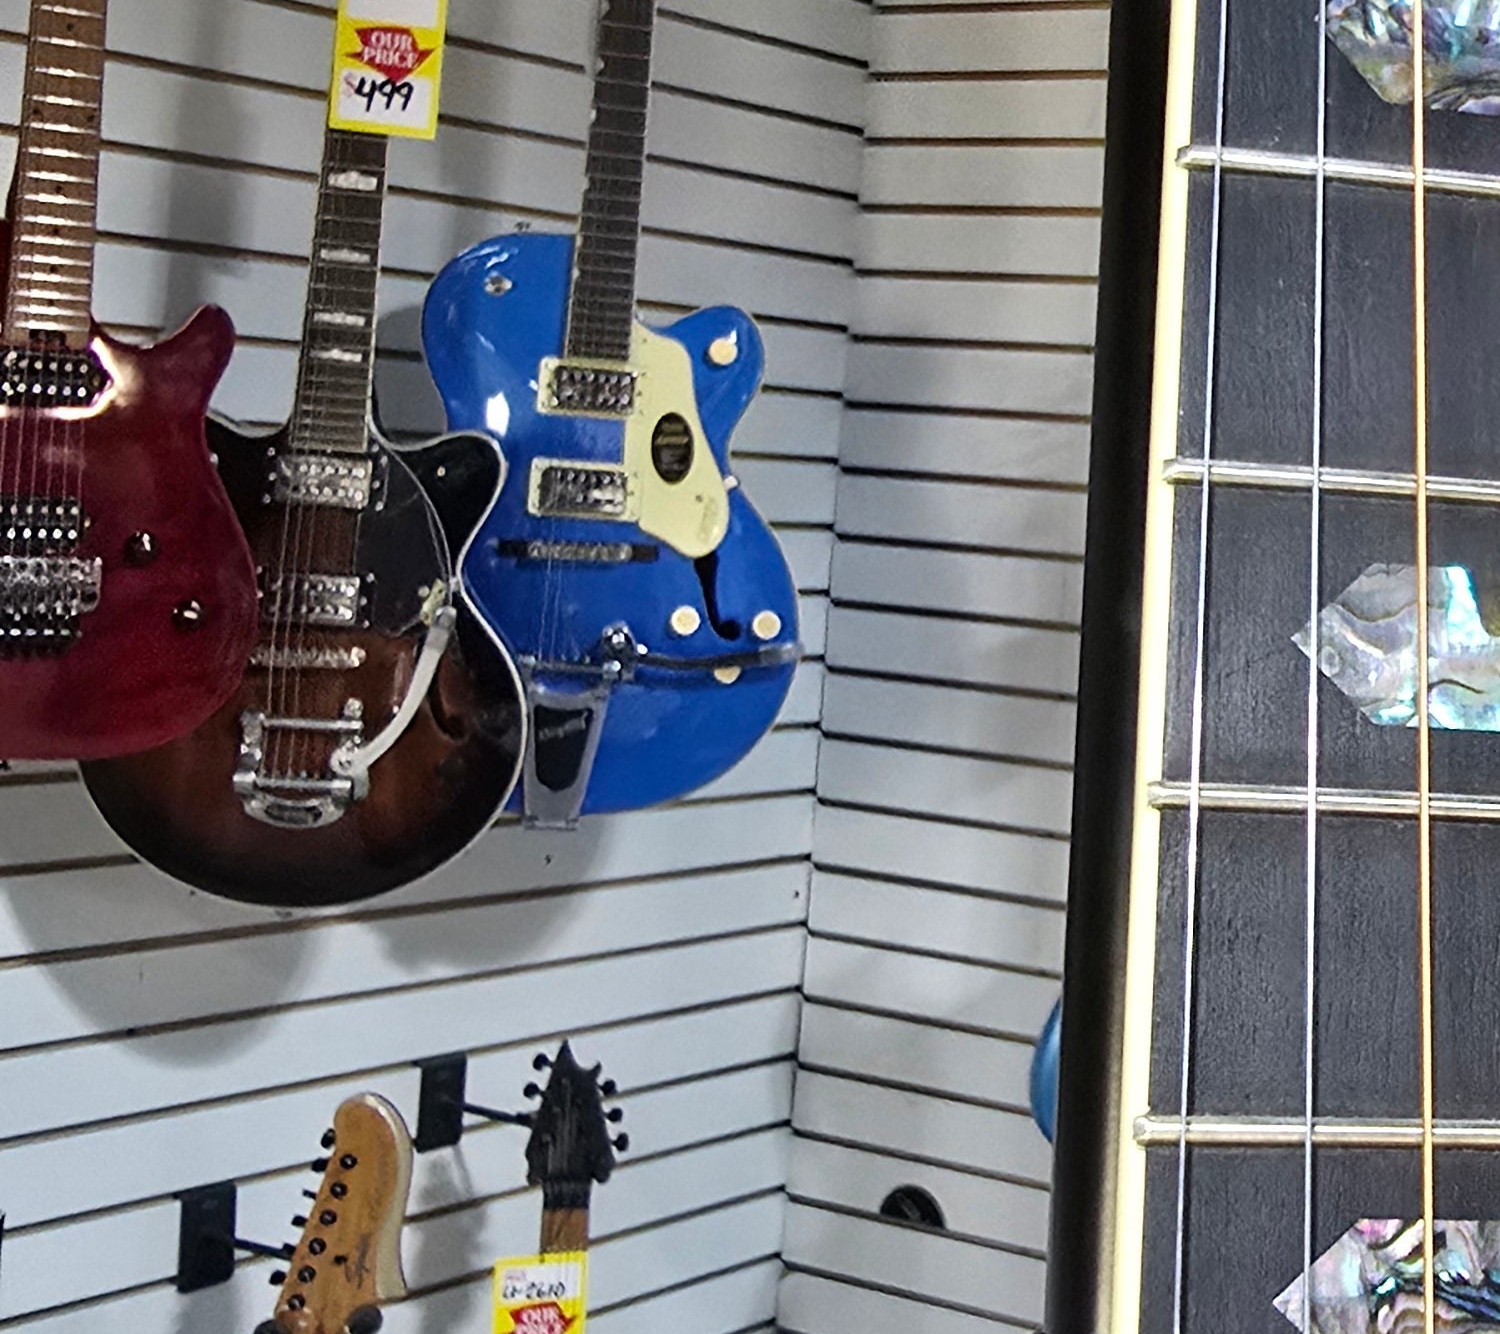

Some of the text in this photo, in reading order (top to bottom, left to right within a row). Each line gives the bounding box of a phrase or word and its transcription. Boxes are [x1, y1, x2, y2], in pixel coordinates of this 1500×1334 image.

[371, 31, 414, 51] OUR
[361, 46, 419, 68] PRICE
[521, 1304, 560, 1326] OUR
